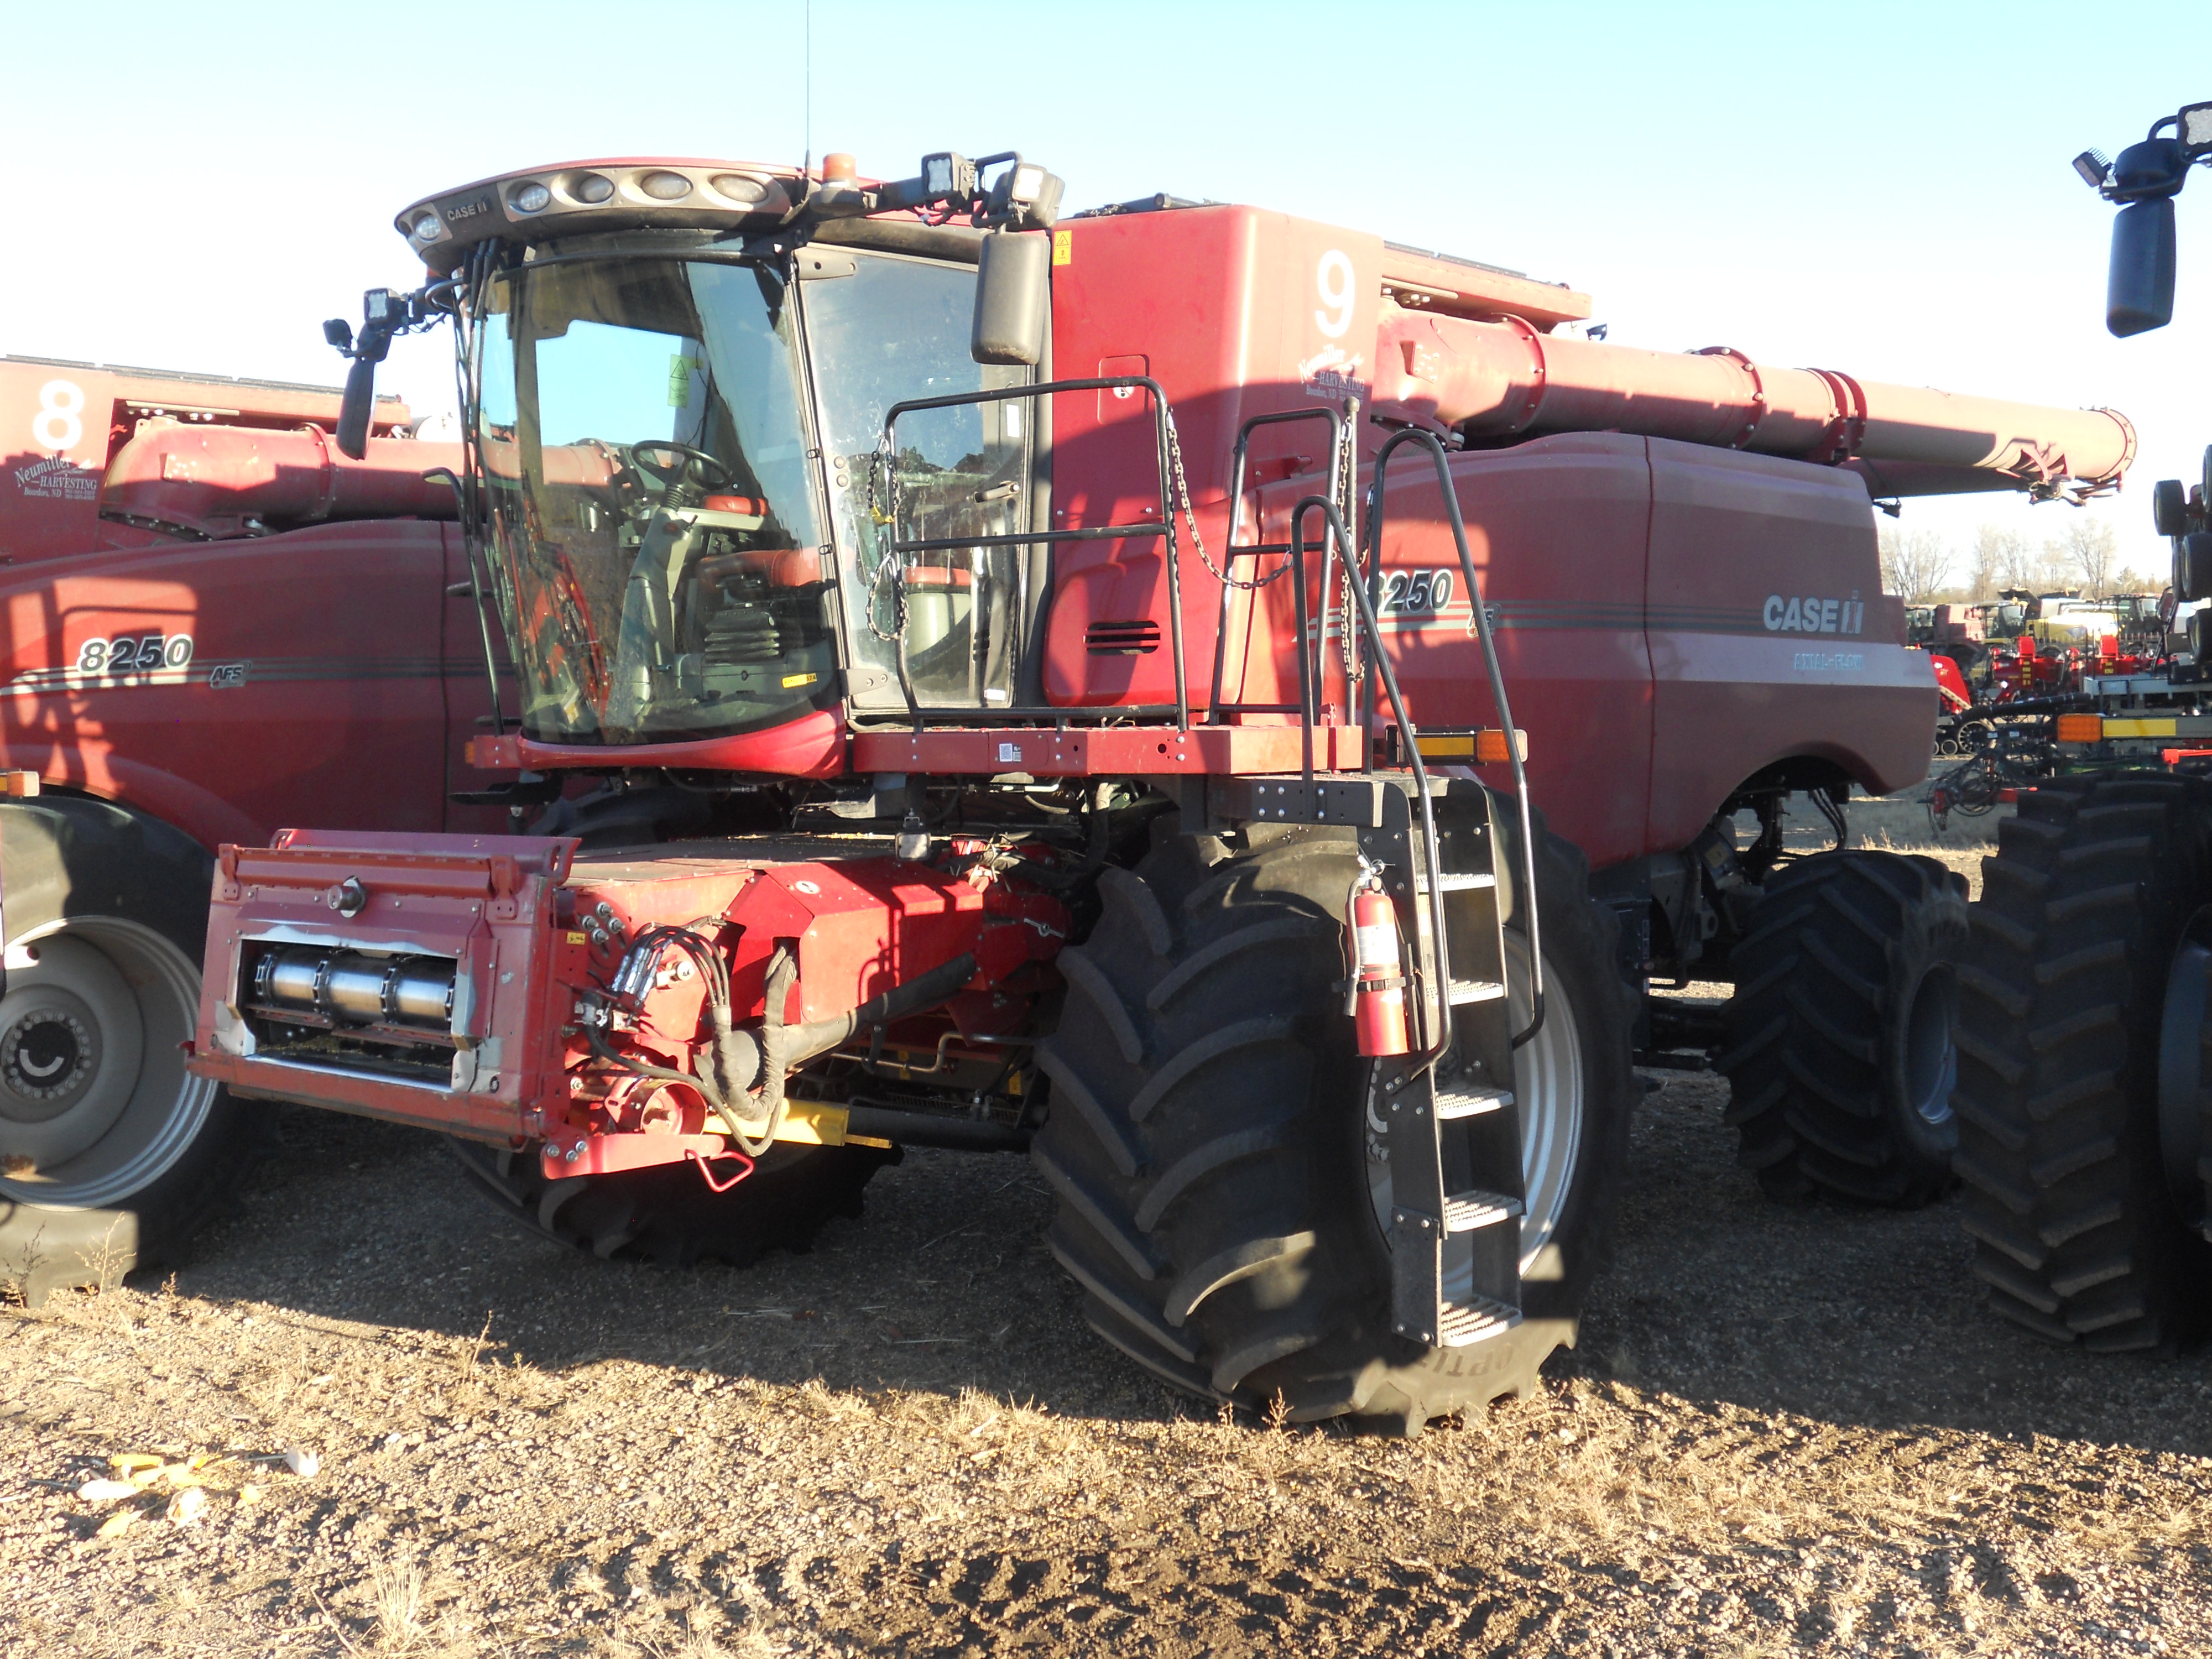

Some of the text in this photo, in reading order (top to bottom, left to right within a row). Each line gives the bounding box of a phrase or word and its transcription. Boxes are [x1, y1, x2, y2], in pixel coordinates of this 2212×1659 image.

[447, 205, 476, 222] CASE
[1315, 249, 1355, 338] 9
[33, 380, 84, 450] 8
[14, 453, 72, 488] Neumiller
[40, 475, 97, 490] HARVESTING
[1764, 594, 1839, 632] CASE
[76, 633, 194, 675] 8250
[210, 665, 244, 681] AFS
